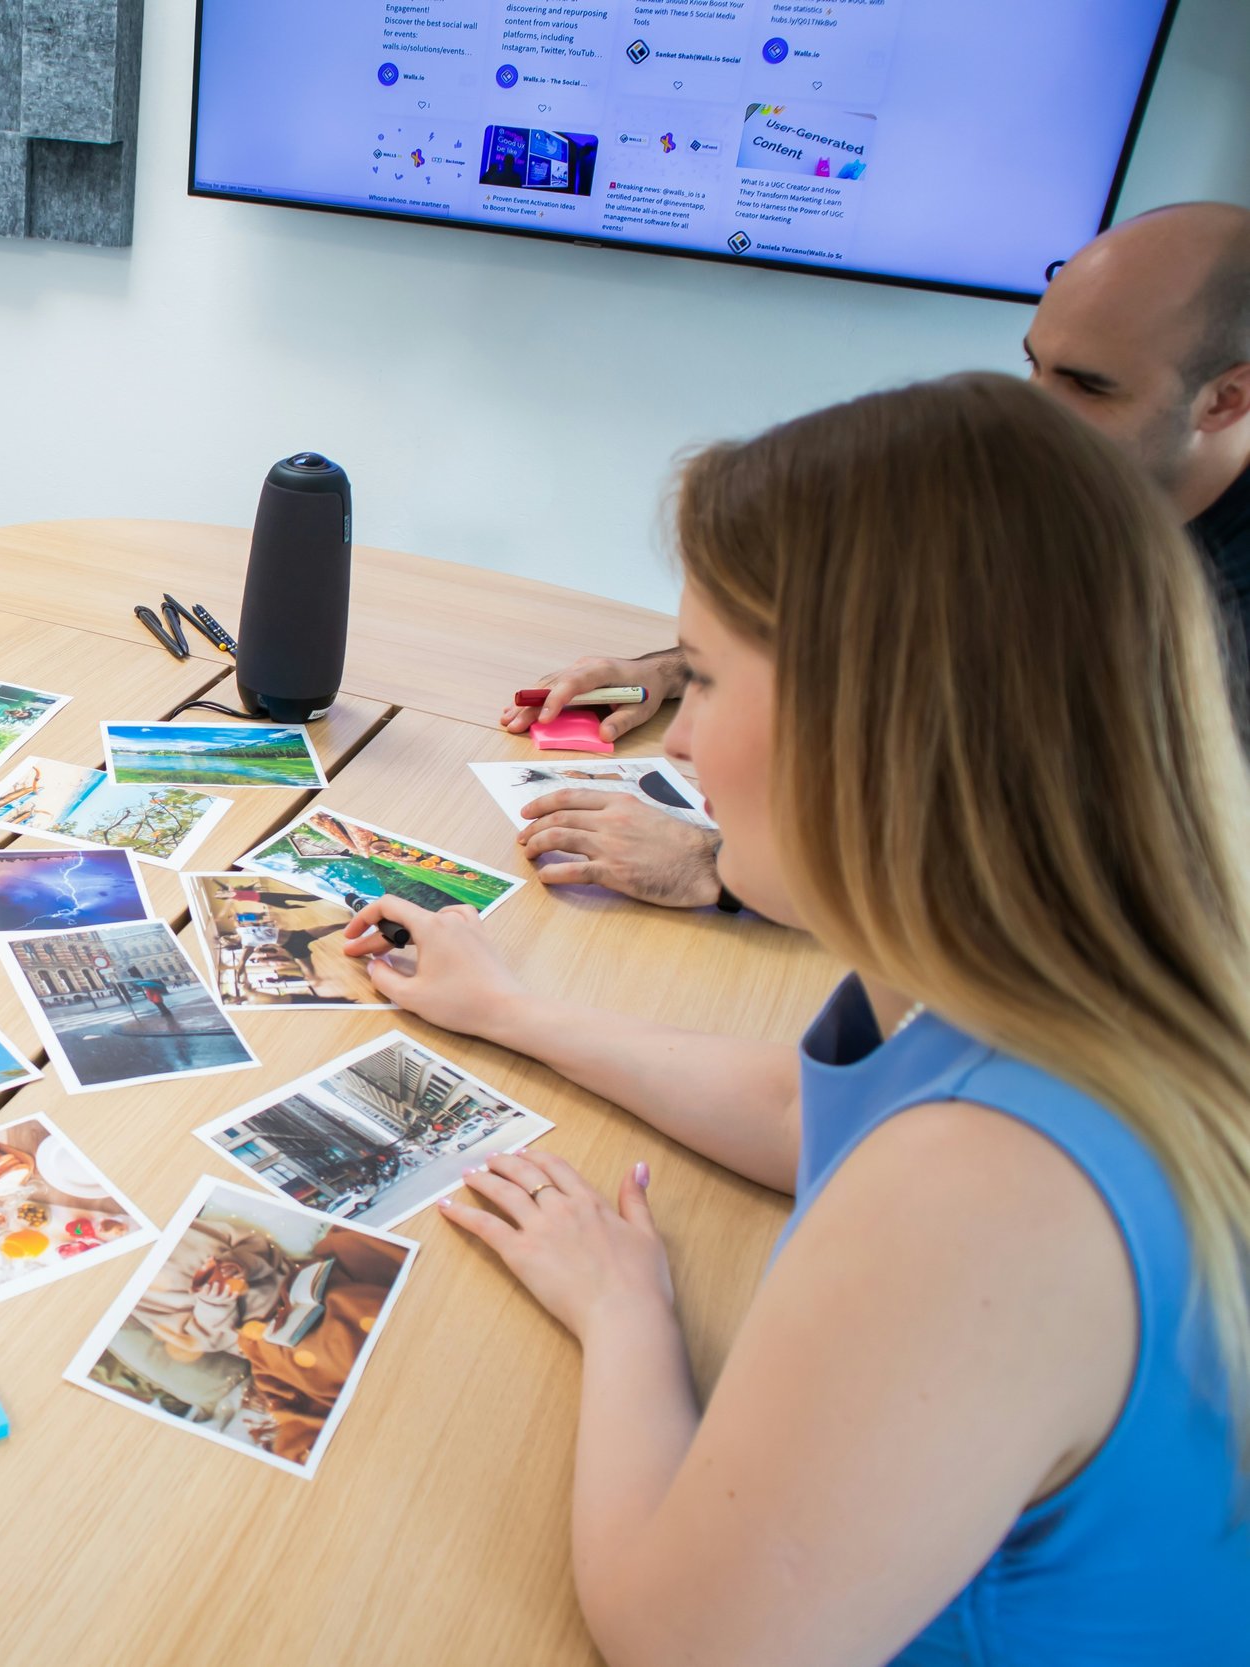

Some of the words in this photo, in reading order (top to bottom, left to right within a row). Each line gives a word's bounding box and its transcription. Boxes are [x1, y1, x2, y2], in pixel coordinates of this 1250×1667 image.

[386, 4, 430, 13] Engagement!
[506, 4, 547, 15] discovering
[563, 9, 608, 19] repurposing
[773, 4, 792, 12] these
[793, 5, 823, 14] statistics
[670, 9, 688, 17] These
[695, 11, 715, 19] Social
[716, 12, 736, 20] Media
[385, 17, 413, 25] Discover
[427, 19, 441, 27] best
[463, 22, 478, 30] wall
[505, 18, 532, 26] content
[533, 19, 550, 27] from
[552, 21, 578, 29] various
[383, 29, 393, 37] for
[503, 30, 539, 41] platforms,
[540, 32, 574, 44] including
[502, 43, 538, 54] Instagram,
[540, 46, 566, 56] Twitter,
[655, 51, 677, 59] Sanket
[794, 50, 820, 58] Walls.io
[498, 136, 516, 146] Good
[766, 119, 865, 156] User-Generated
[752, 136, 803, 160] Content
[617, 183, 643, 193] Breaking
[741, 178, 758, 186] What
[771, 181, 785, 189] UGC
[786, 182, 810, 191] Creator
[607, 193, 631, 201] certified
[632, 196, 655, 204] partner
[740, 188, 755, 197] They
[756, 190, 789, 200] Transform
[790, 195, 822, 205] Marketing
[823, 198, 842, 206] Learn
[492, 195, 512, 203] Proven
[514, 197, 530, 205] Event
[531, 199, 559, 208] Activation
[560, 202, 576, 211] Ideas
[490, 204, 506, 212] Boost
[507, 205, 519, 213] Your
[520, 207, 537, 215] Event
[616, 205, 641, 213] ultimate
[642, 207, 671, 216] all-in-one
[760, 203, 787, 211] Harness
[788, 205, 798, 213] the
[799, 207, 820, 216] Power
[603, 214, 643, 223] management
[644, 218, 670, 227] software
[735, 211, 758, 219] Creator
[759, 213, 792, 225] Marketing
[756, 243, 780, 251] Daniela
